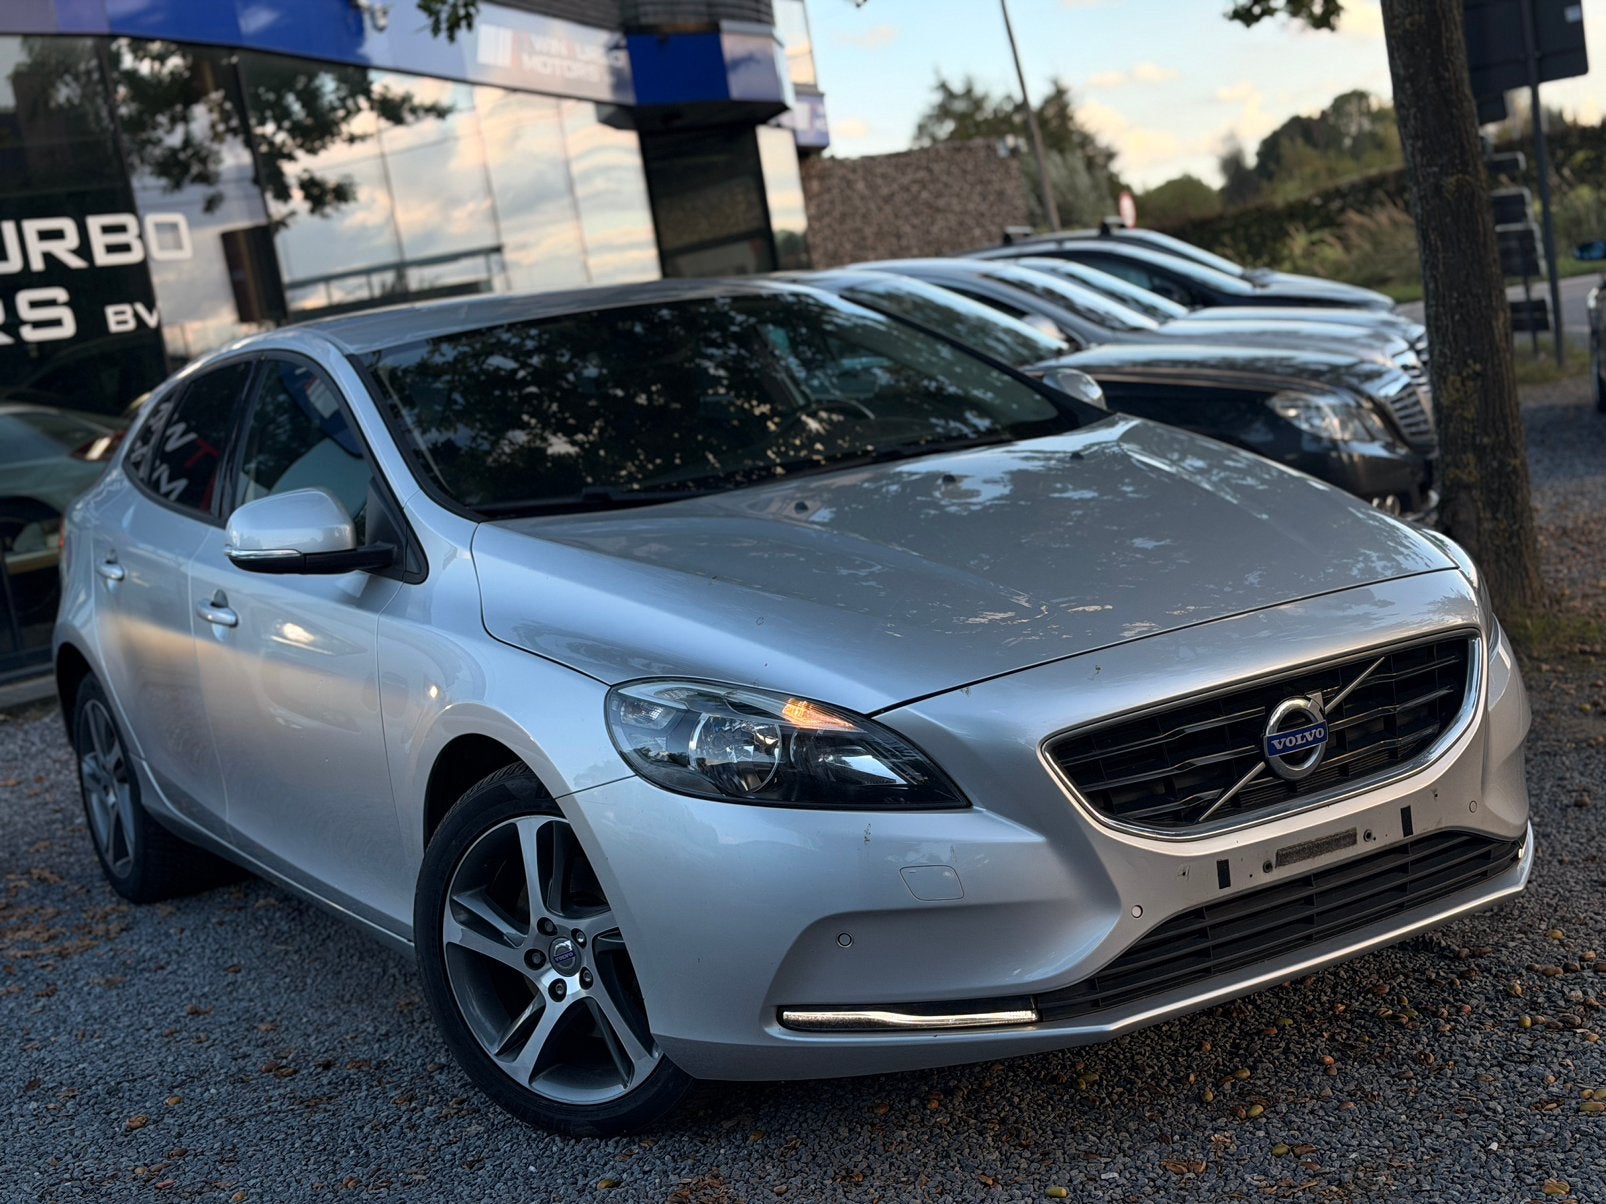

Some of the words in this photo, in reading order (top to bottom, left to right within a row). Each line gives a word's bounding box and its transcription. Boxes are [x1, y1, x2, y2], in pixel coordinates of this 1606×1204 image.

[0, 287, 77, 345] S
[104, 302, 160, 334] BV
[1271, 728, 1325, 750] VOLVO
